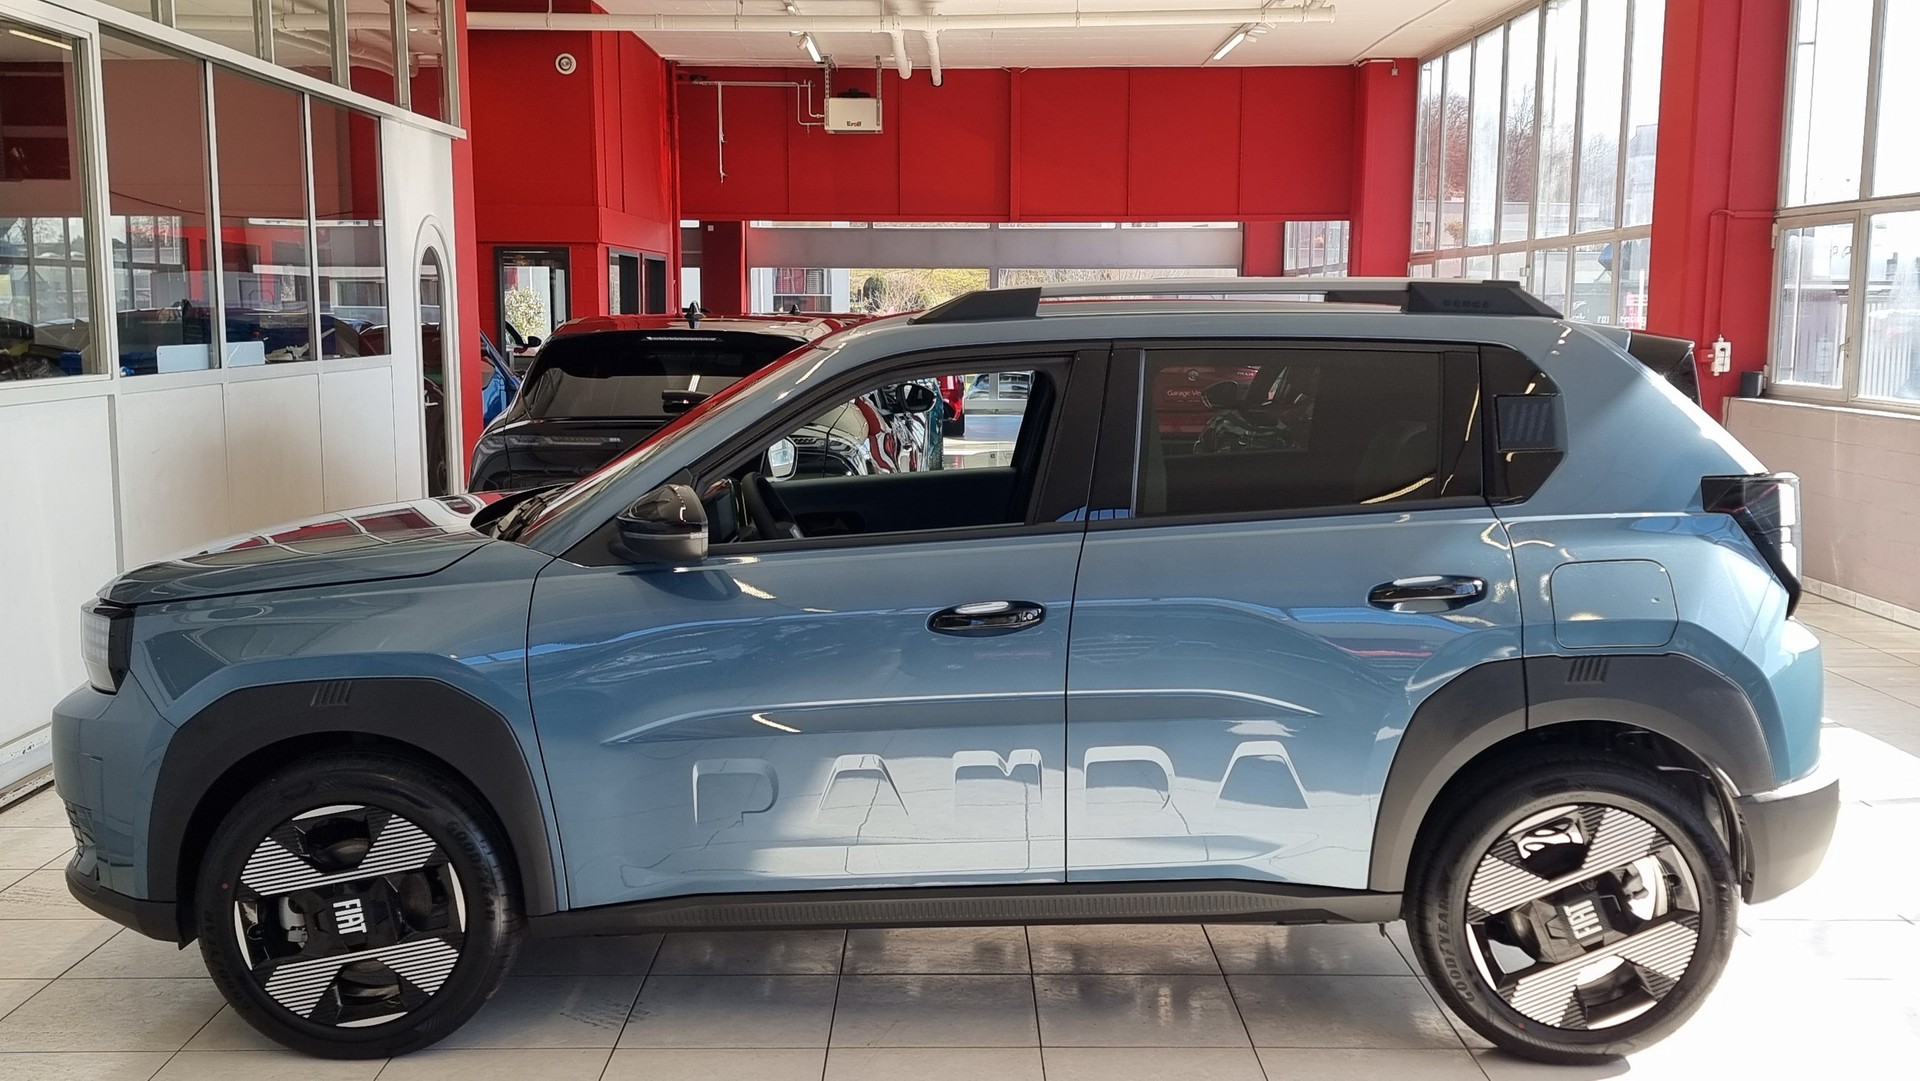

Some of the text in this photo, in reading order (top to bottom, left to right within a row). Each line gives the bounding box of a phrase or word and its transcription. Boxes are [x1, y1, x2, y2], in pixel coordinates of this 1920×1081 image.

[333, 898, 367, 935] FIAT
[1561, 899, 1603, 940] FIAT
[1437, 898, 1476, 1003] GOODYEAR
